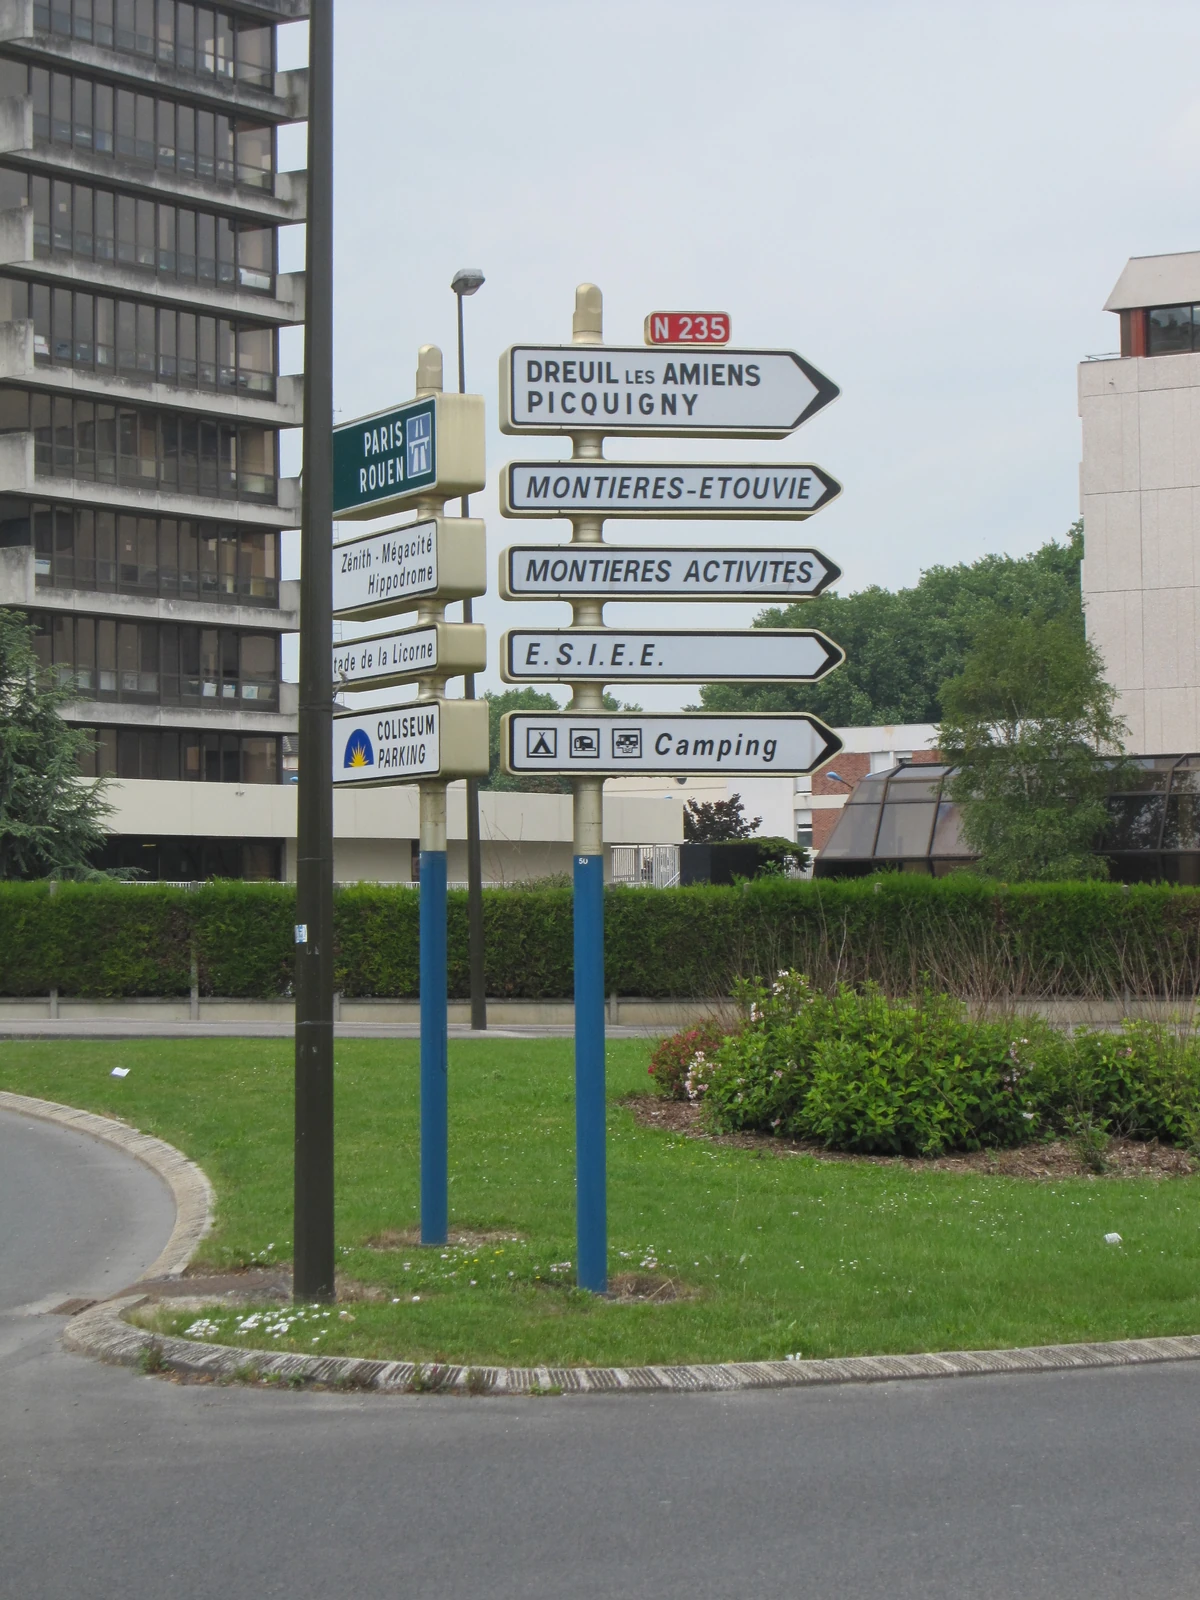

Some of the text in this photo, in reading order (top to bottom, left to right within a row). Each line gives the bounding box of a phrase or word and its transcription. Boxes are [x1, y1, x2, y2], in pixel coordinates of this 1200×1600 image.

[654, 317, 726, 340] N 235
[527, 360, 761, 387] DREUIL LES AMIENS
[528, 391, 699, 416] PICQUIGNY
[364, 421, 403, 457] PARIS
[359, 456, 404, 493] ROUEN
[526, 476, 812, 499] MONTIERES-ETOUVIE
[341, 548, 372, 573] Zénith
[382, 532, 432, 565] Mégacité
[368, 565, 433, 597] Hippodrome
[525, 559, 813, 584] MONTIERES ACTIVITES
[333, 642, 433, 674] tade de la Licorne
[525, 643, 663, 666] E.S.I.E.E.
[377, 714, 435, 741] COLISEUM
[378, 743, 426, 768] PARKING
[654, 732, 778, 762] Camping
